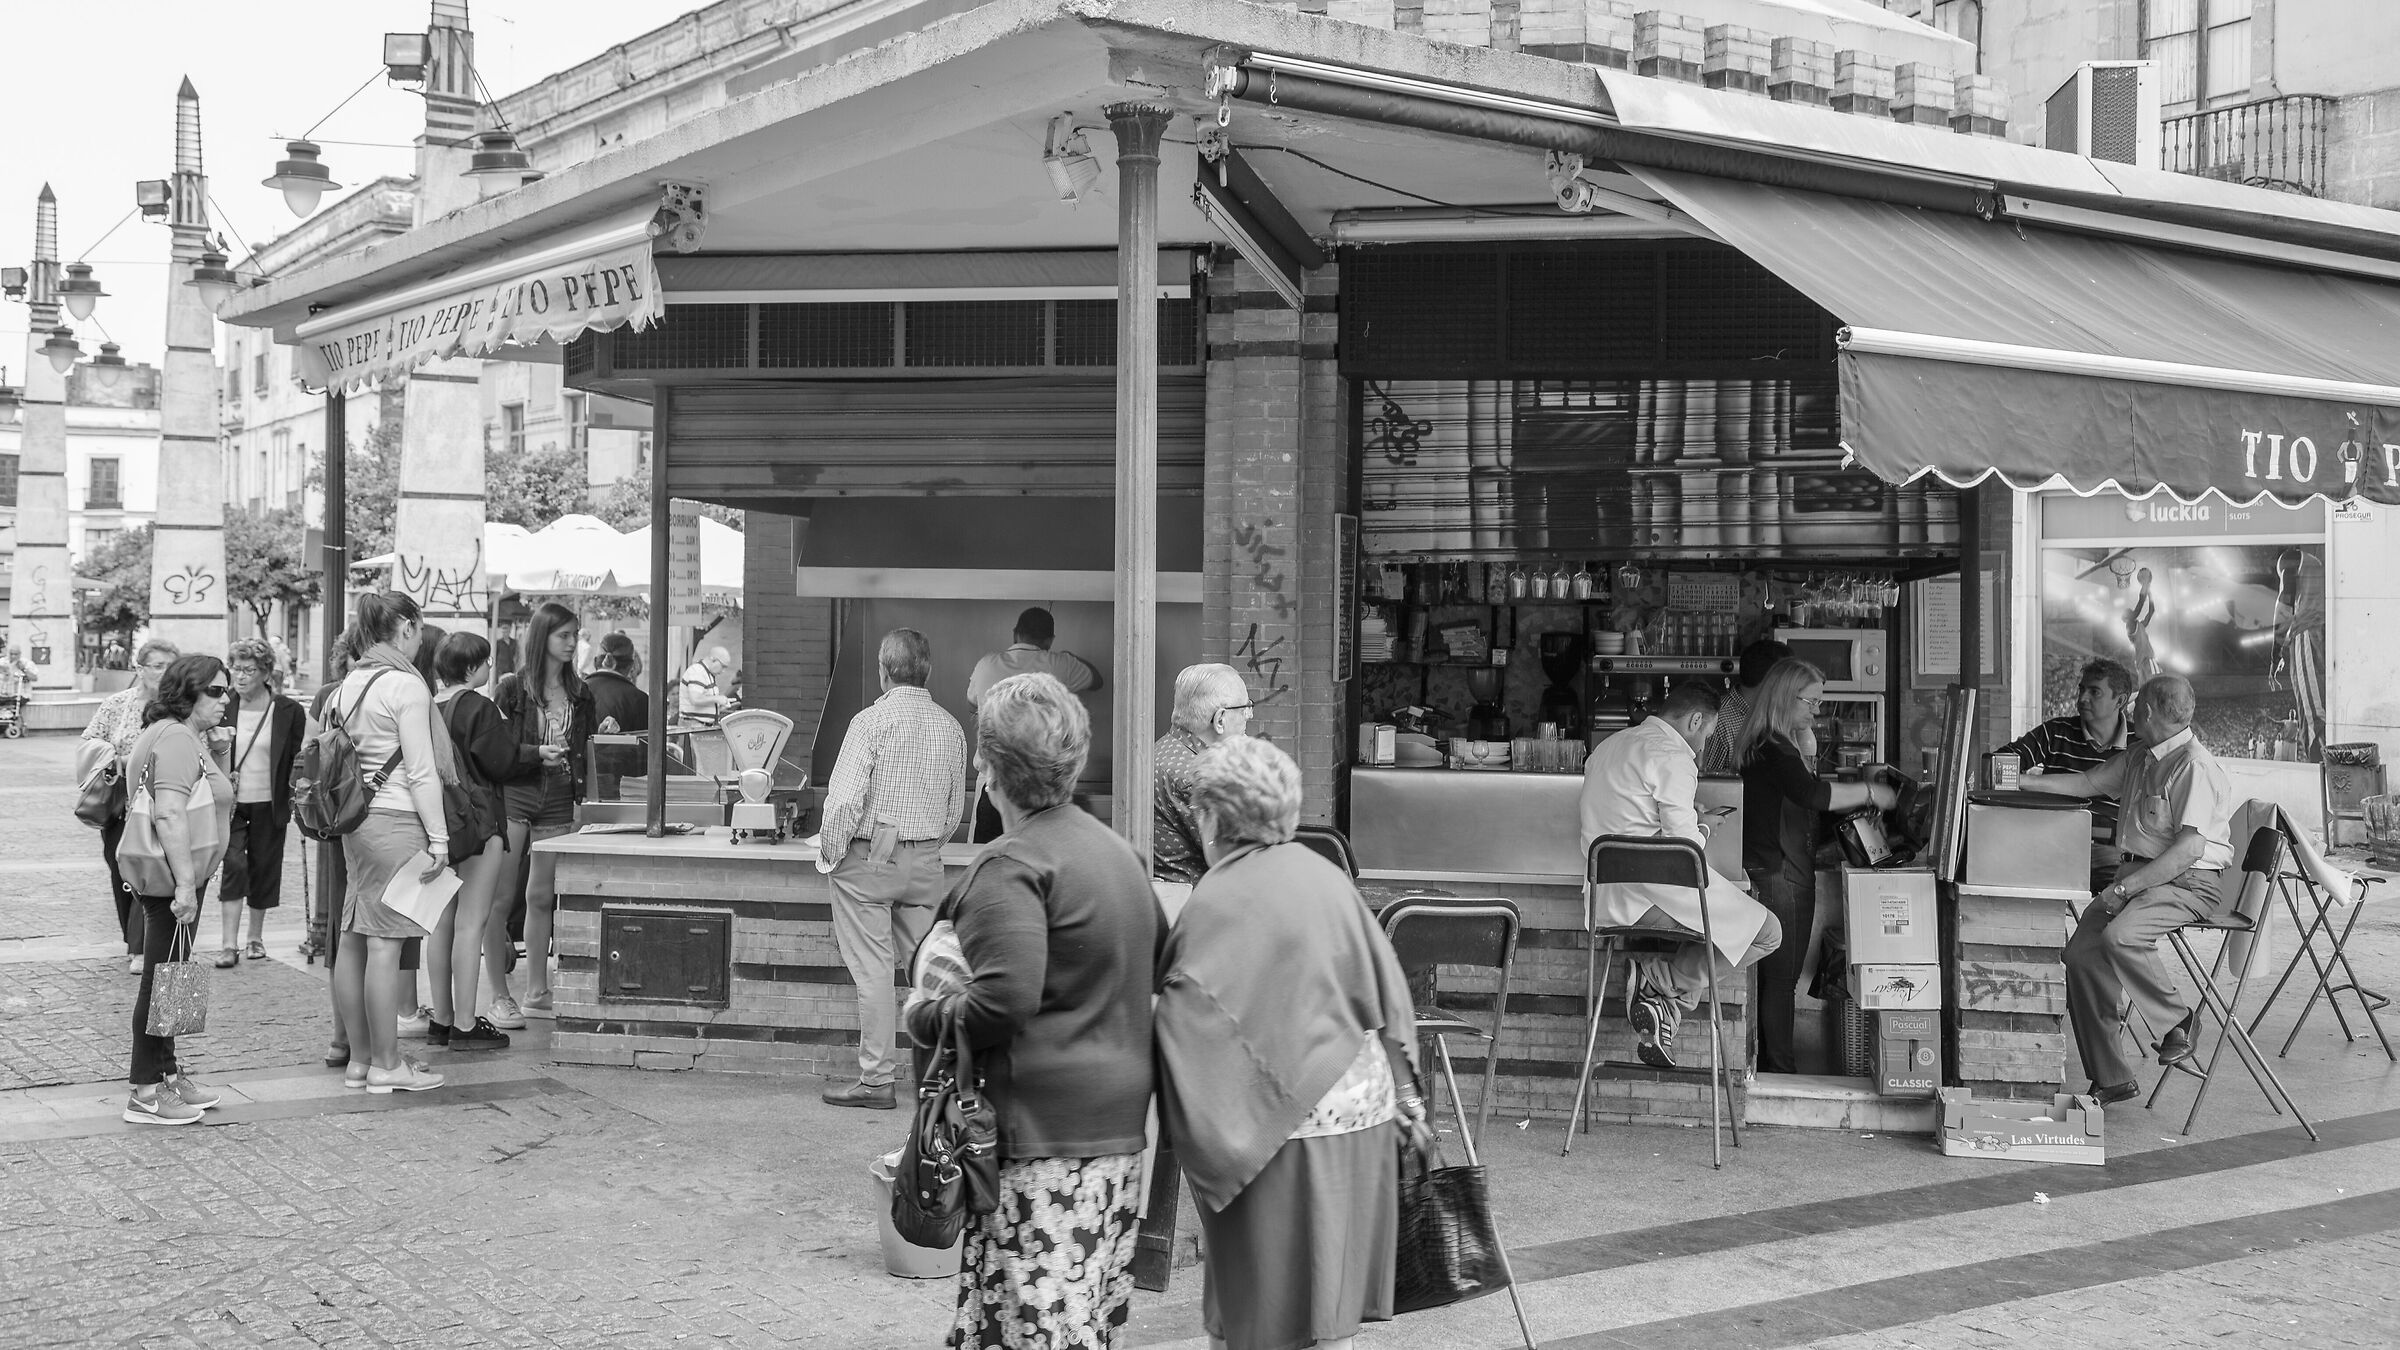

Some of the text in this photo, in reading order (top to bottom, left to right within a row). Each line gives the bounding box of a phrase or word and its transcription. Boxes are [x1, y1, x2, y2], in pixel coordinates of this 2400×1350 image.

[319, 264, 643, 372] TIO PEPE TIO PEPE TIO PEPE
[2241, 428, 2318, 483] TIO
[2149, 502, 2211, 522] luckia
[2228, 512, 2251, 521] SLOTS
[1892, 1020, 1927, 1029] Pascual
[1922, 1052, 1929, 1060] 8
[1888, 1078, 1933, 1088] CLASSIC
[2011, 1133, 2085, 1145] Las Virtudes
